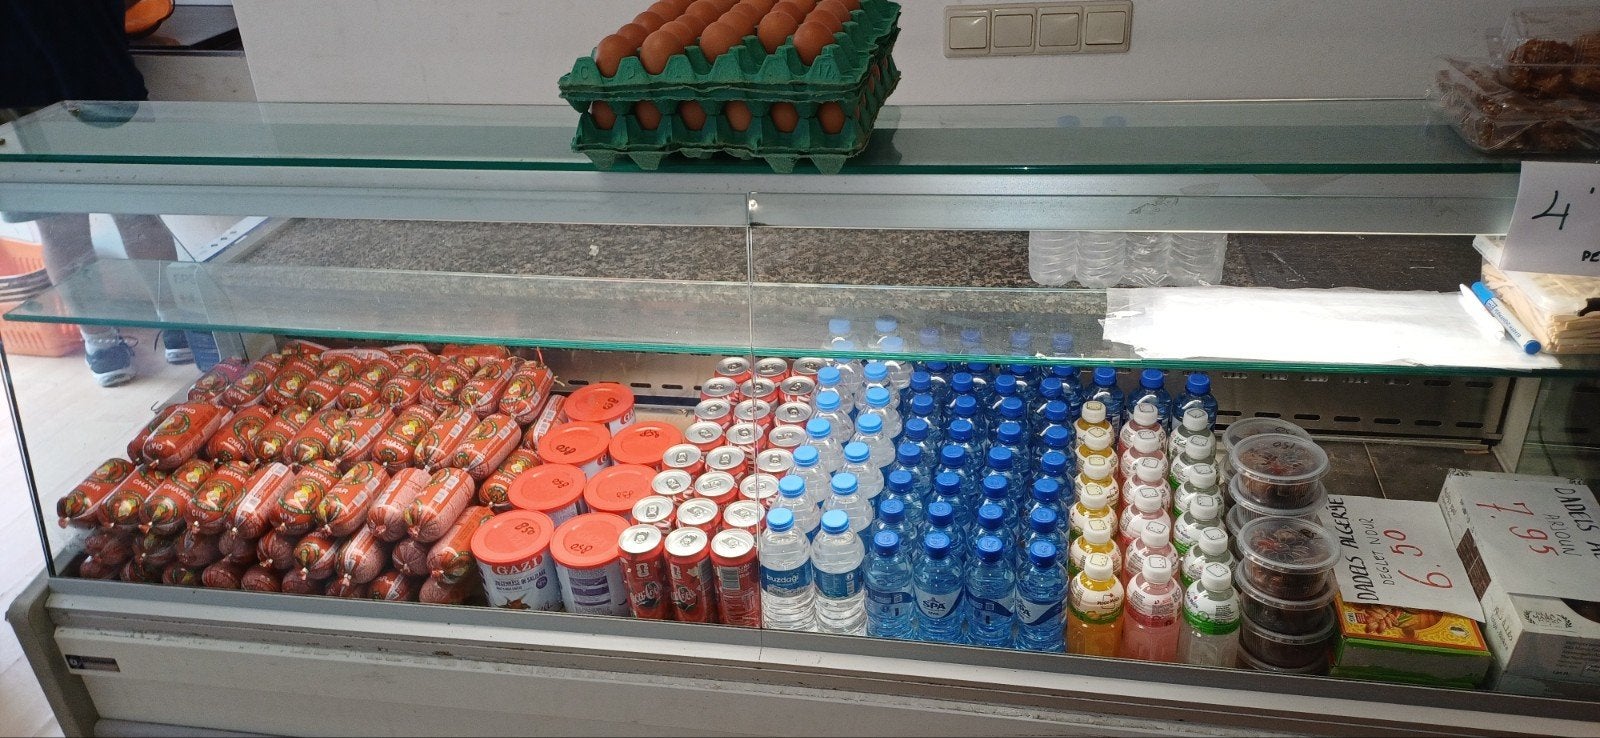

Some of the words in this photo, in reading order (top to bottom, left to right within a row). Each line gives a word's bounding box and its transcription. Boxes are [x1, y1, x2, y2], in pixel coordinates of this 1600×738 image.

[1554, 487, 1600, 532] DADELS
[514, 522, 536, 536] 850
[1358, 518, 1382, 545] NOUR
[496, 557, 541, 576] GAZI
[1344, 555, 1380, 601] DADELS
[1371, 550, 1395, 586] DEGLET
[922, 599, 947, 610] SPA
